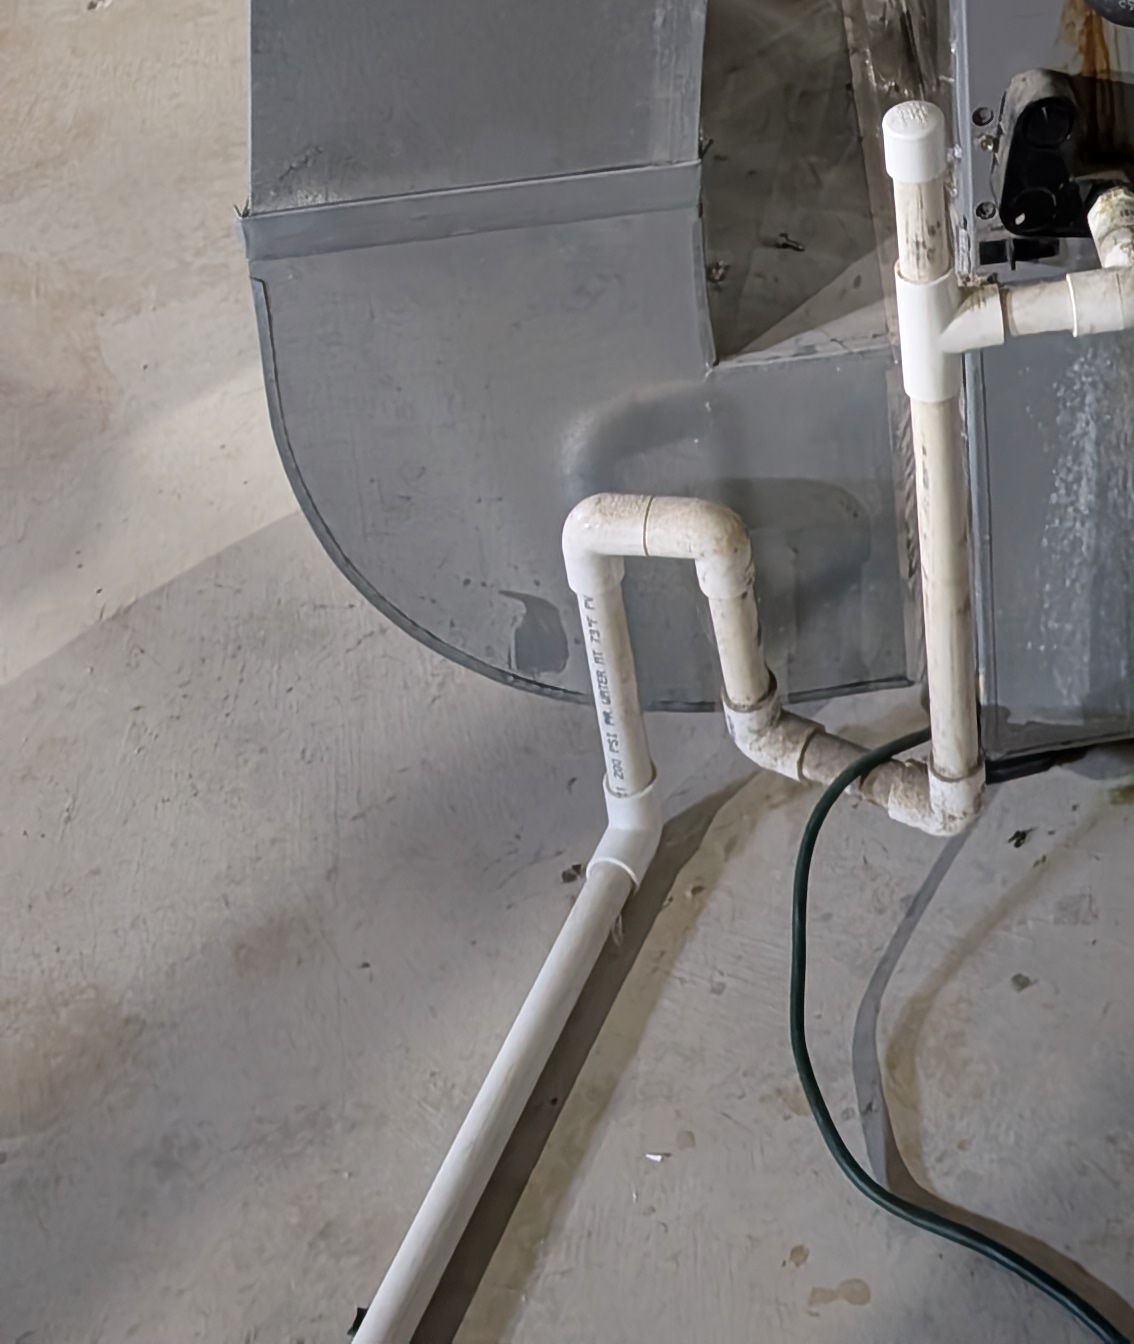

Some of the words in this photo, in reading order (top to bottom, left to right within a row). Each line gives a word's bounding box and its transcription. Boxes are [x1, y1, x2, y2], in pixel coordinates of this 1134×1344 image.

[592, 649, 605, 665] AT
[596, 670, 612, 706] WATER
[607, 732, 620, 754] PSI
